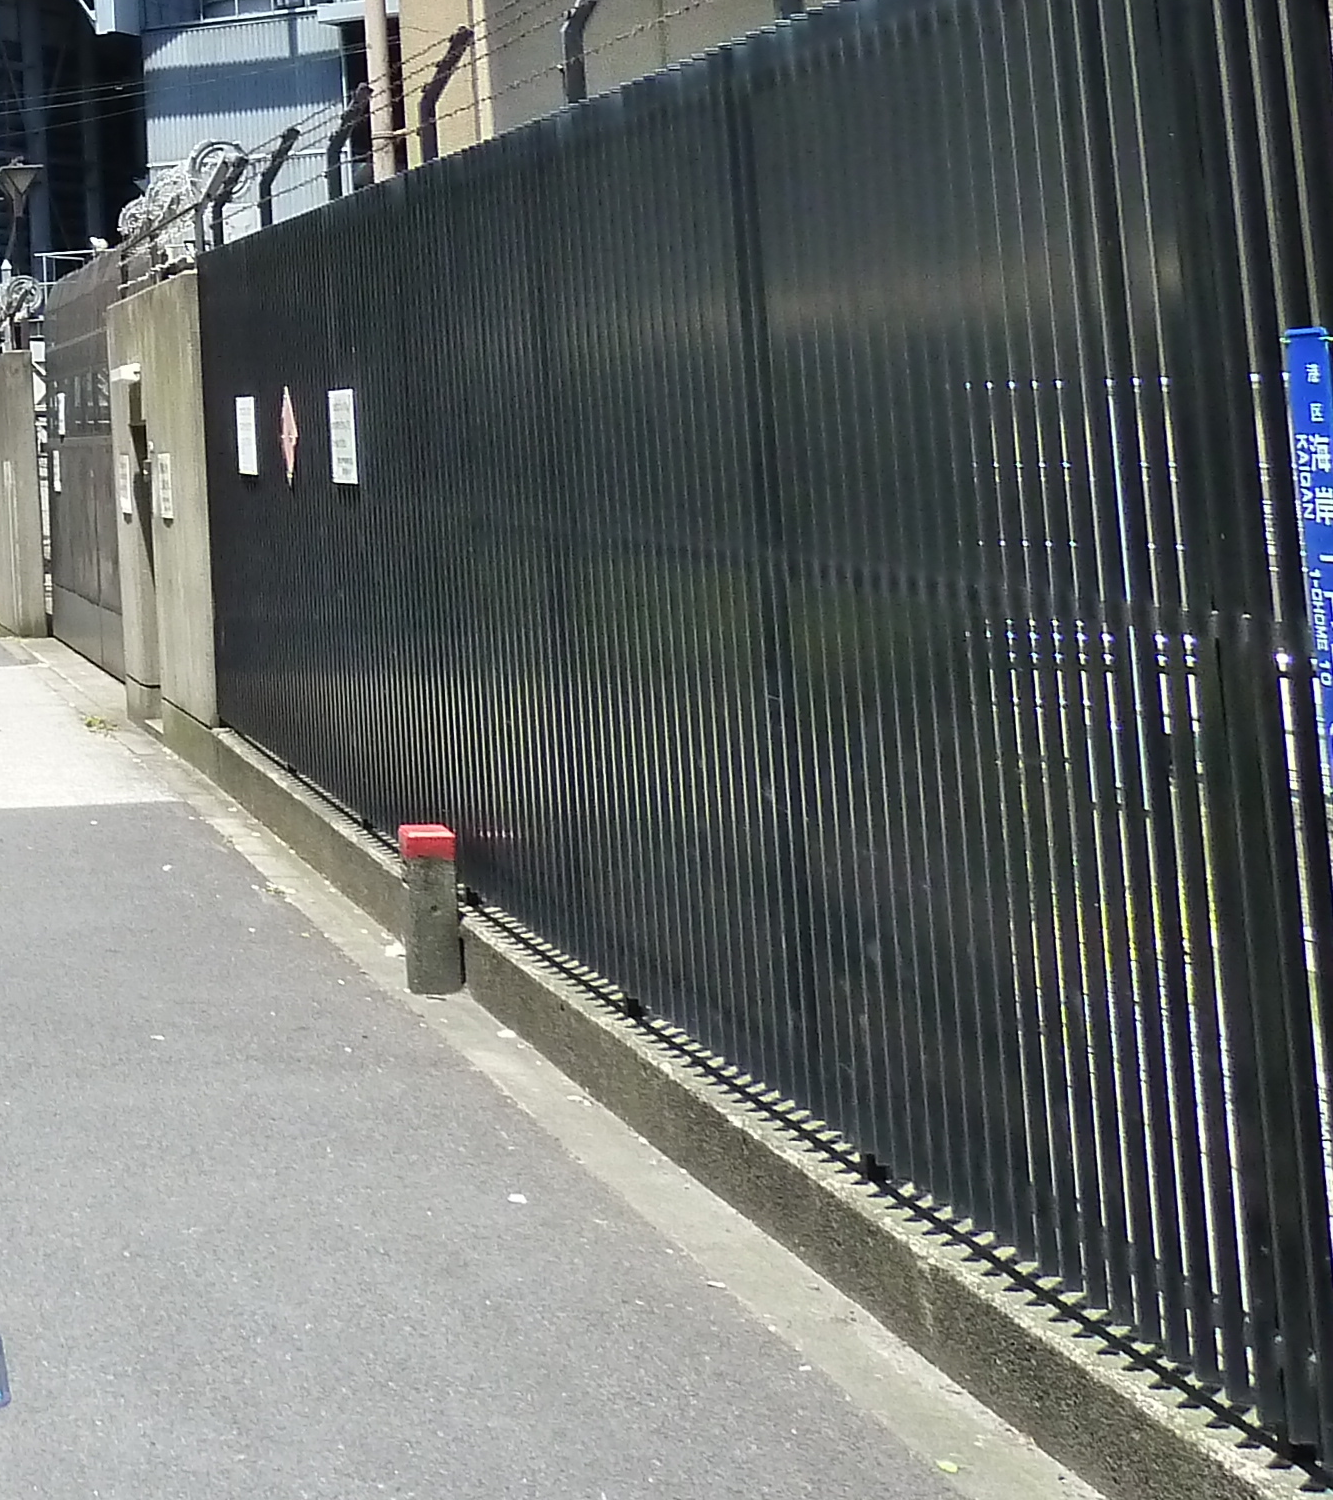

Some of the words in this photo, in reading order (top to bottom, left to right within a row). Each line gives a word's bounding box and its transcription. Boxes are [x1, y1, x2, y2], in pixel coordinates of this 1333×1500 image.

[1295, 434, 1315, 520] KAIGAN
[1309, 568, 1329, 651] 1-CHOME
[1318, 659, 1332, 686] 10
